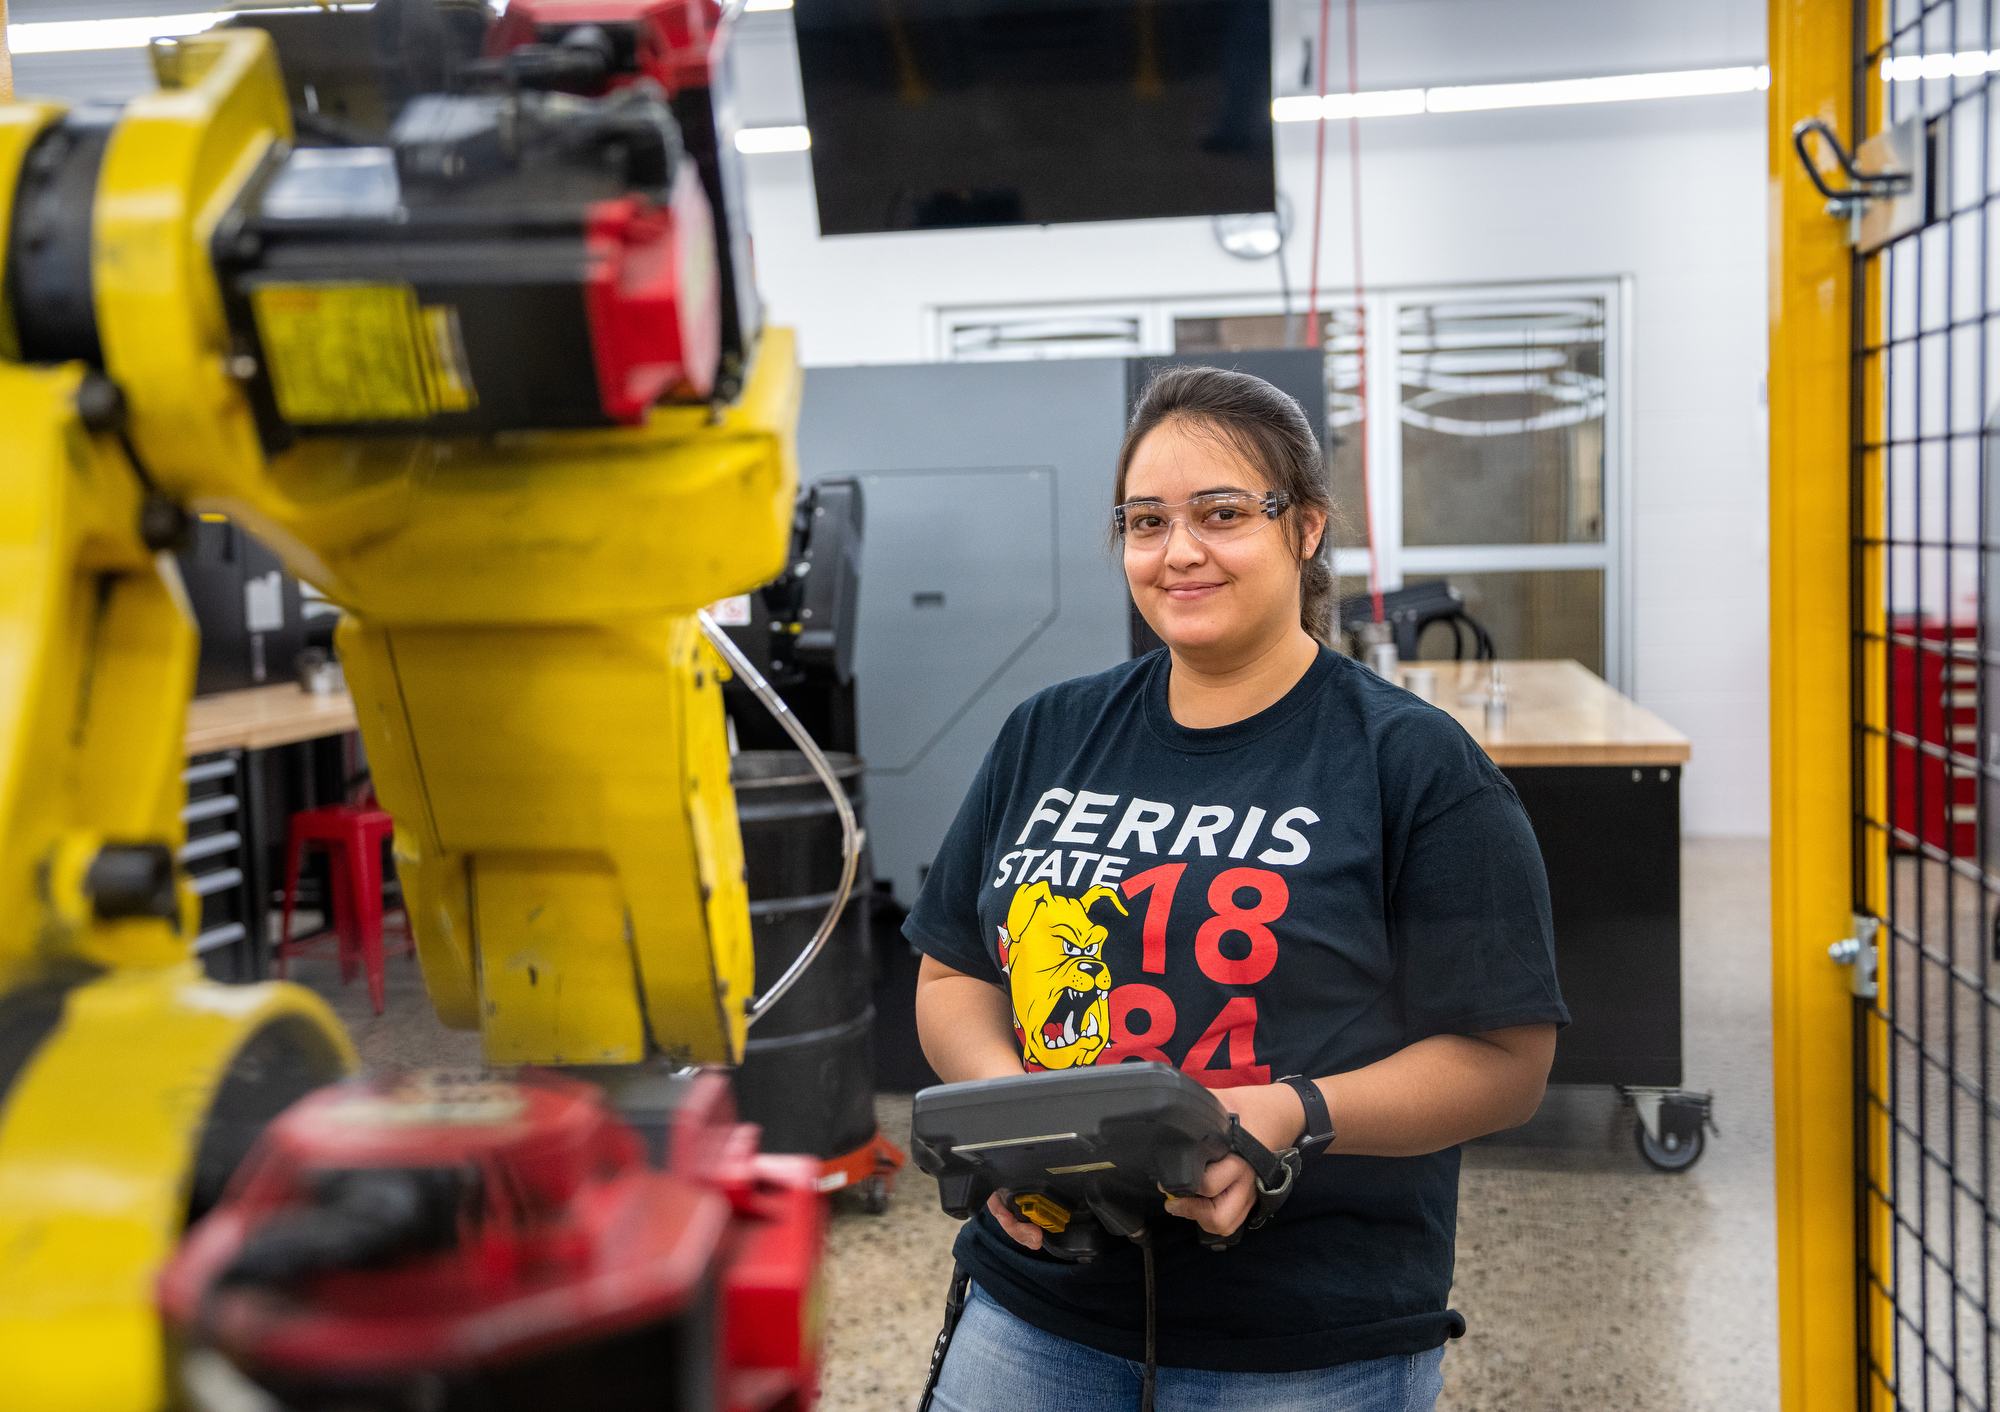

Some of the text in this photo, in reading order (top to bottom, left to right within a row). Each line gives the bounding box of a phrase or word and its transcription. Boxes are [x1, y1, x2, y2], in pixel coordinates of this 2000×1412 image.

[1015, 788, 1320, 865] FERRIS
[994, 849, 1130, 889] STATE
[1120, 863, 1290, 985] 18
